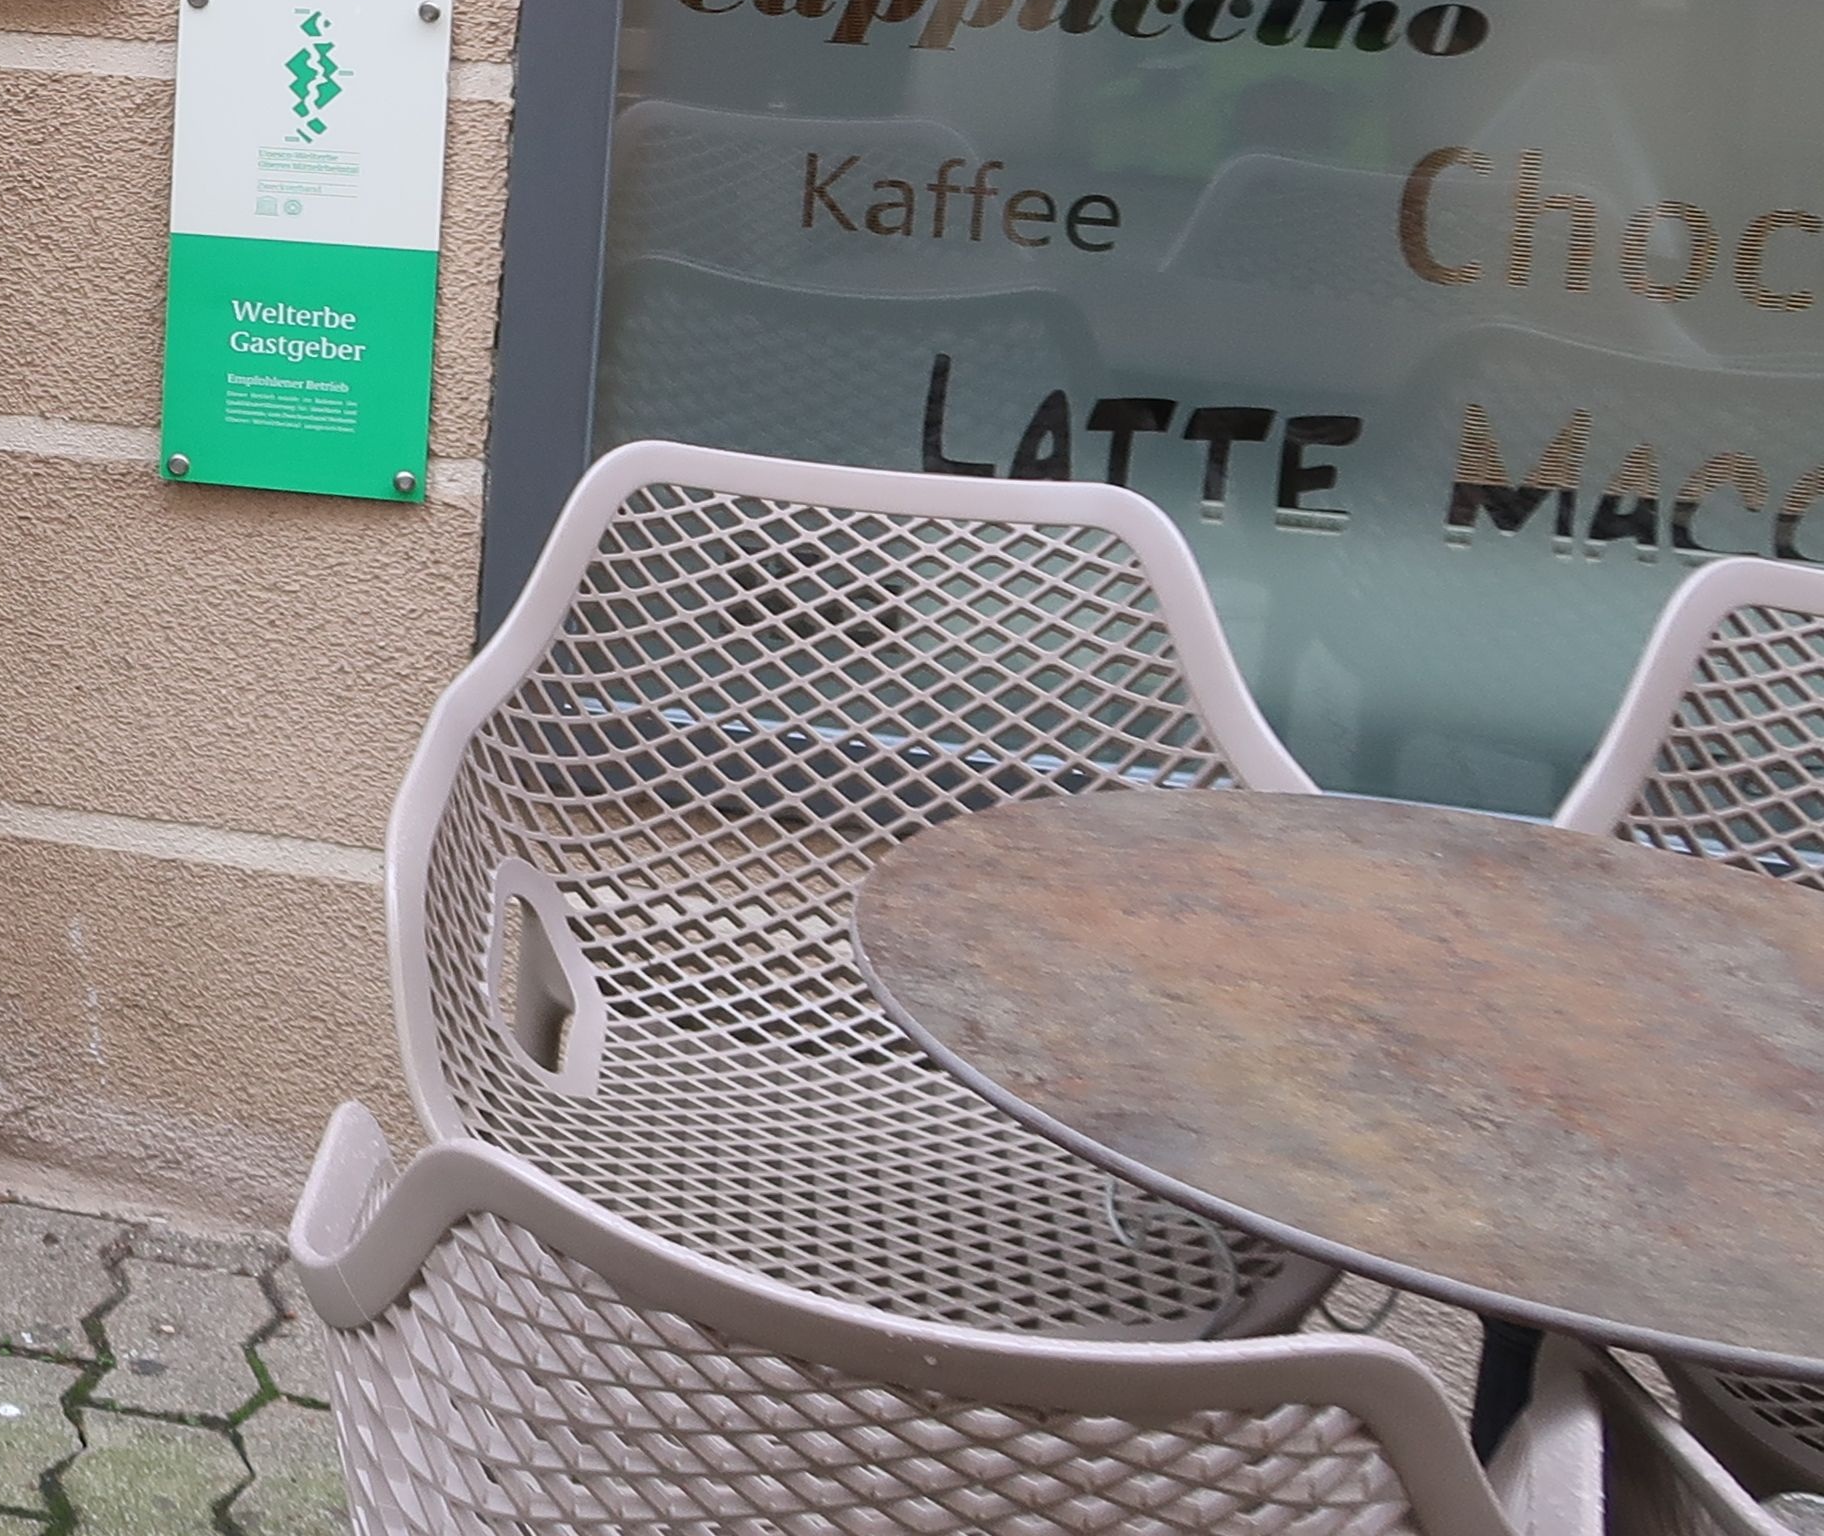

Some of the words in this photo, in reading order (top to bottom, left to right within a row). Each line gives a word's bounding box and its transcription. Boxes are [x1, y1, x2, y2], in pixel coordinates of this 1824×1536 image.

[800, 151, 1123, 254] Kaffee
[1397, 145, 1824, 314] Choc
[229, 331, 366, 362] Gastgeber
[231, 300, 357, 330] Welterbe
[227, 373, 304, 389] Empfohlener
[306, 380, 349, 393] Betrieb
[922, 354, 1363, 532] LATTE
